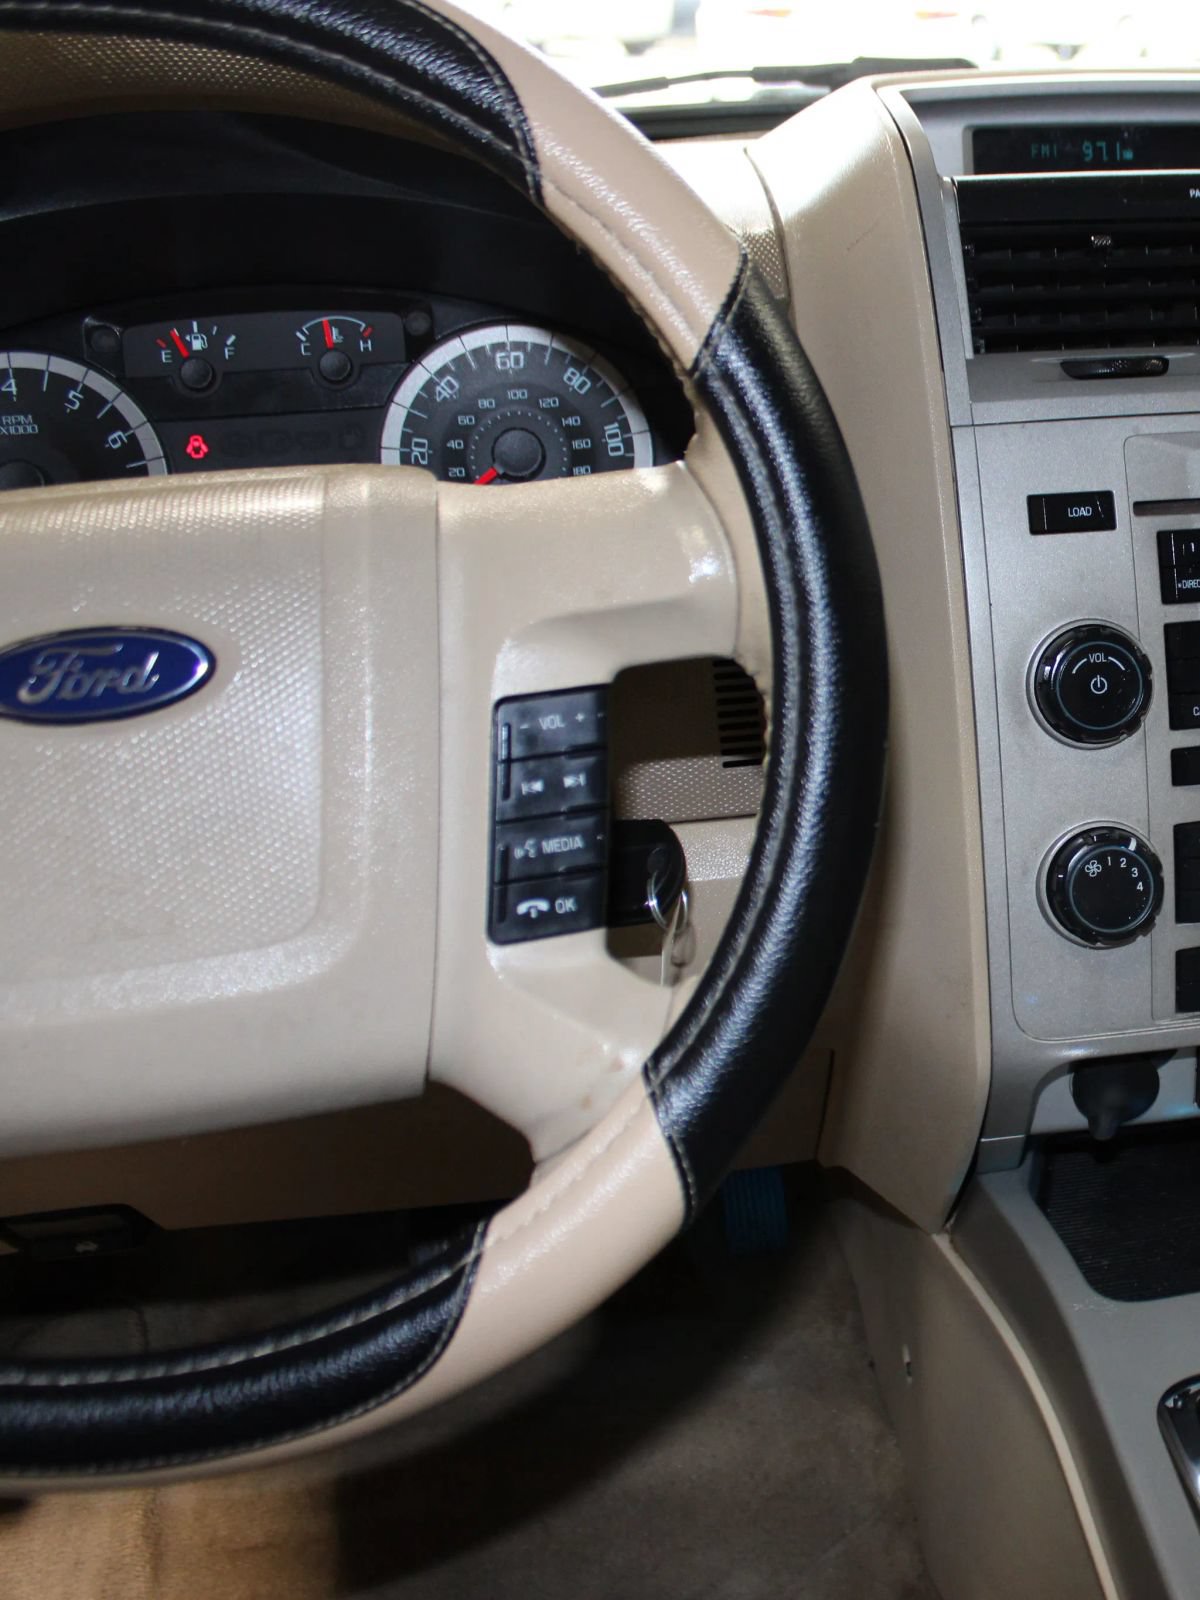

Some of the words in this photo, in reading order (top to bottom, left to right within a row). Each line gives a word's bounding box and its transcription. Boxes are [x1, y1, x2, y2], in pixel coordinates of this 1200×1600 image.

[360, 340, 372, 352] H
[161, 350, 172, 362] E
[225, 347, 235, 360] F
[496, 351, 525, 370] 60
[1, 379, 17, 395] 4
[563, 367, 592, 395] 80
[435, 376, 460, 402] 40
[507, 388, 529, 400] 100
[64, 390, 84, 411] 5
[478, 398, 496, 409] 80
[539, 397, 560, 408] 120
[2, 414, 33, 425] RPM
[458, 415, 475, 425] 60
[562, 416, 581, 426] 140
[107, 430, 128, 449] 6
[446, 439, 464, 449] 40
[571, 439, 591, 449] 160
[603, 422, 625, 457] 100
[411, 438, 429, 465] 20
[448, 467, 466, 477] 20
[572, 465, 591, 475] 180
[1067, 505, 1092, 517] LOAD
[1190, 542, 1195, 552] 1
[1088, 652, 1107, 663] VOL
[17, 642, 160, 704] Ford
[539, 713, 565, 731] VOL
[541, 835, 584, 855] MEDIA
[1107, 856, 1112, 866] 1
[1120, 857, 1127, 868] 2
[1131, 867, 1139, 878] 3
[1136, 881, 1144, 892] 4
[555, 898, 577, 914] OK
